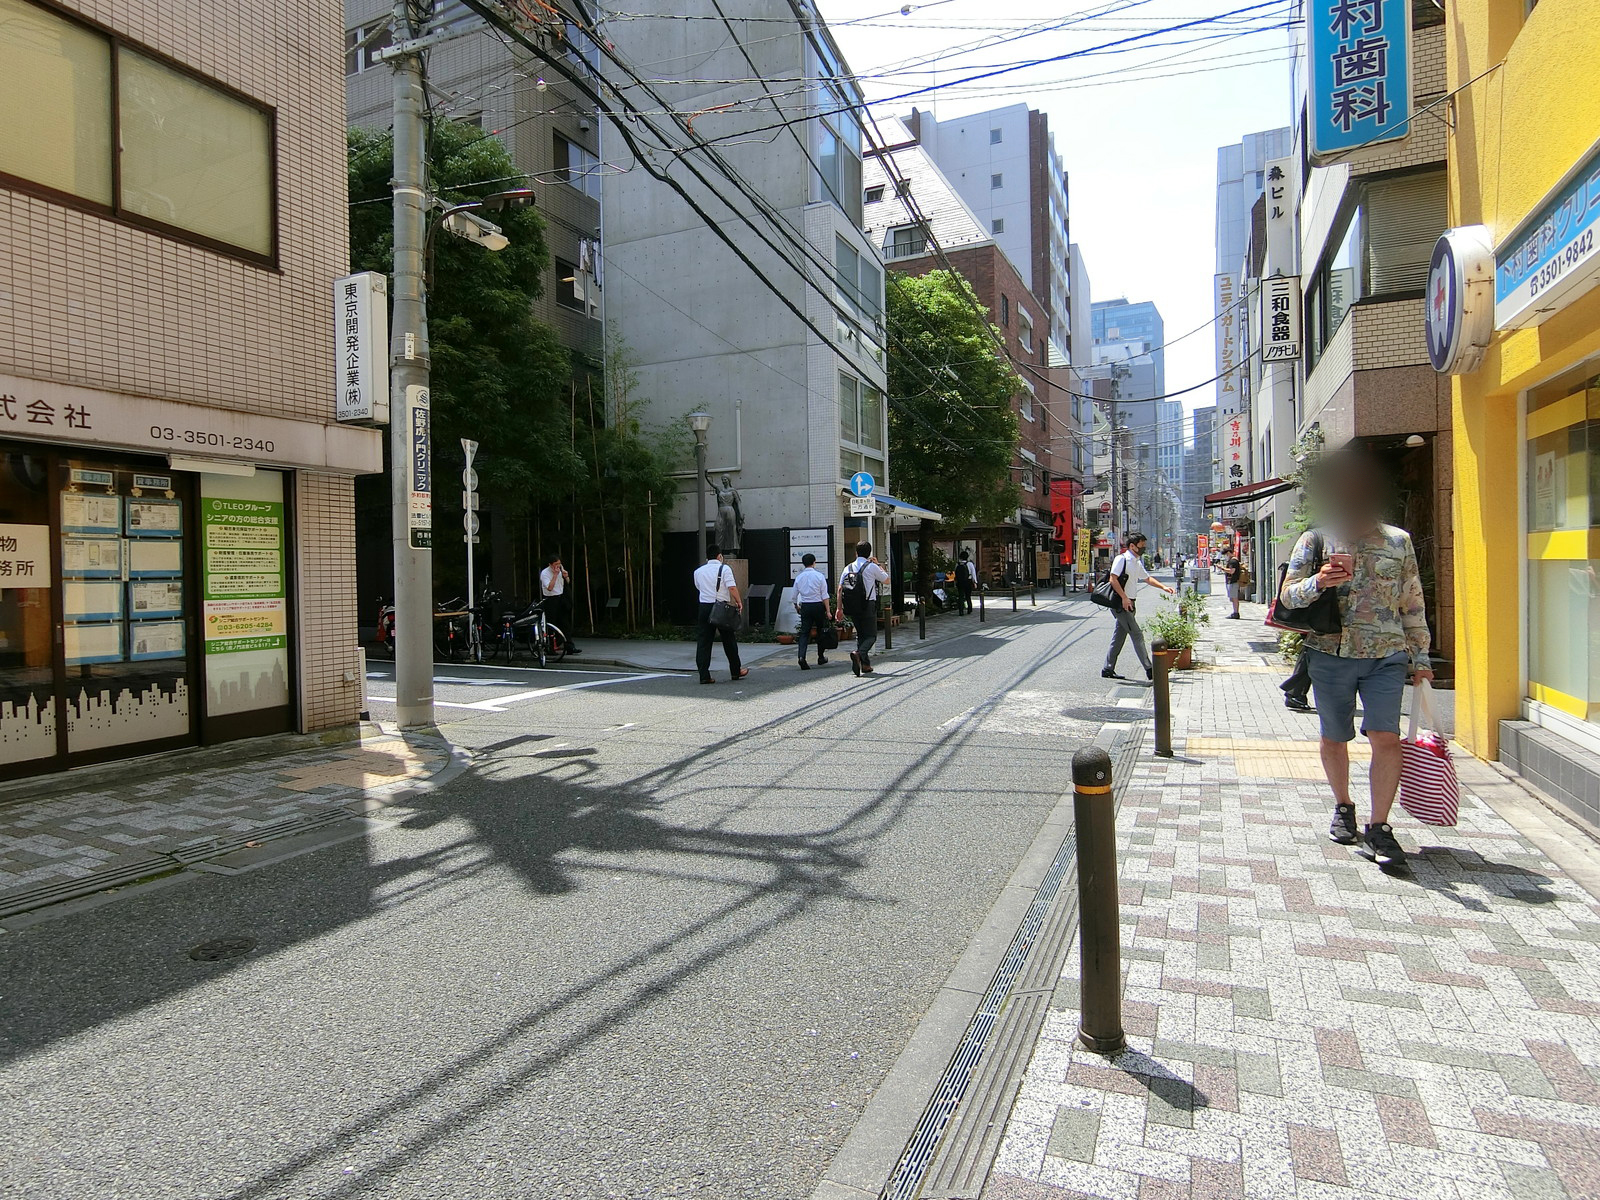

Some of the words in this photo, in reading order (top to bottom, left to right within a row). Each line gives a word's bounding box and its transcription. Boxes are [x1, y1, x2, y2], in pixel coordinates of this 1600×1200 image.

[1328, 0, 1392, 133] 村歯科
[1539, 229, 1593, 289] 3501-9842
[1271, 281, 1290, 341] 三和食器
[338, 408, 369, 418] 3501-2340
[150, 426, 275, 453] 03-3501-2340
[415, 409, 427, 491] 佐野虎ノ門クリニック
[206, 513, 279, 525] シニアの方の総合支援
[0, 535, 17, 552] 物
